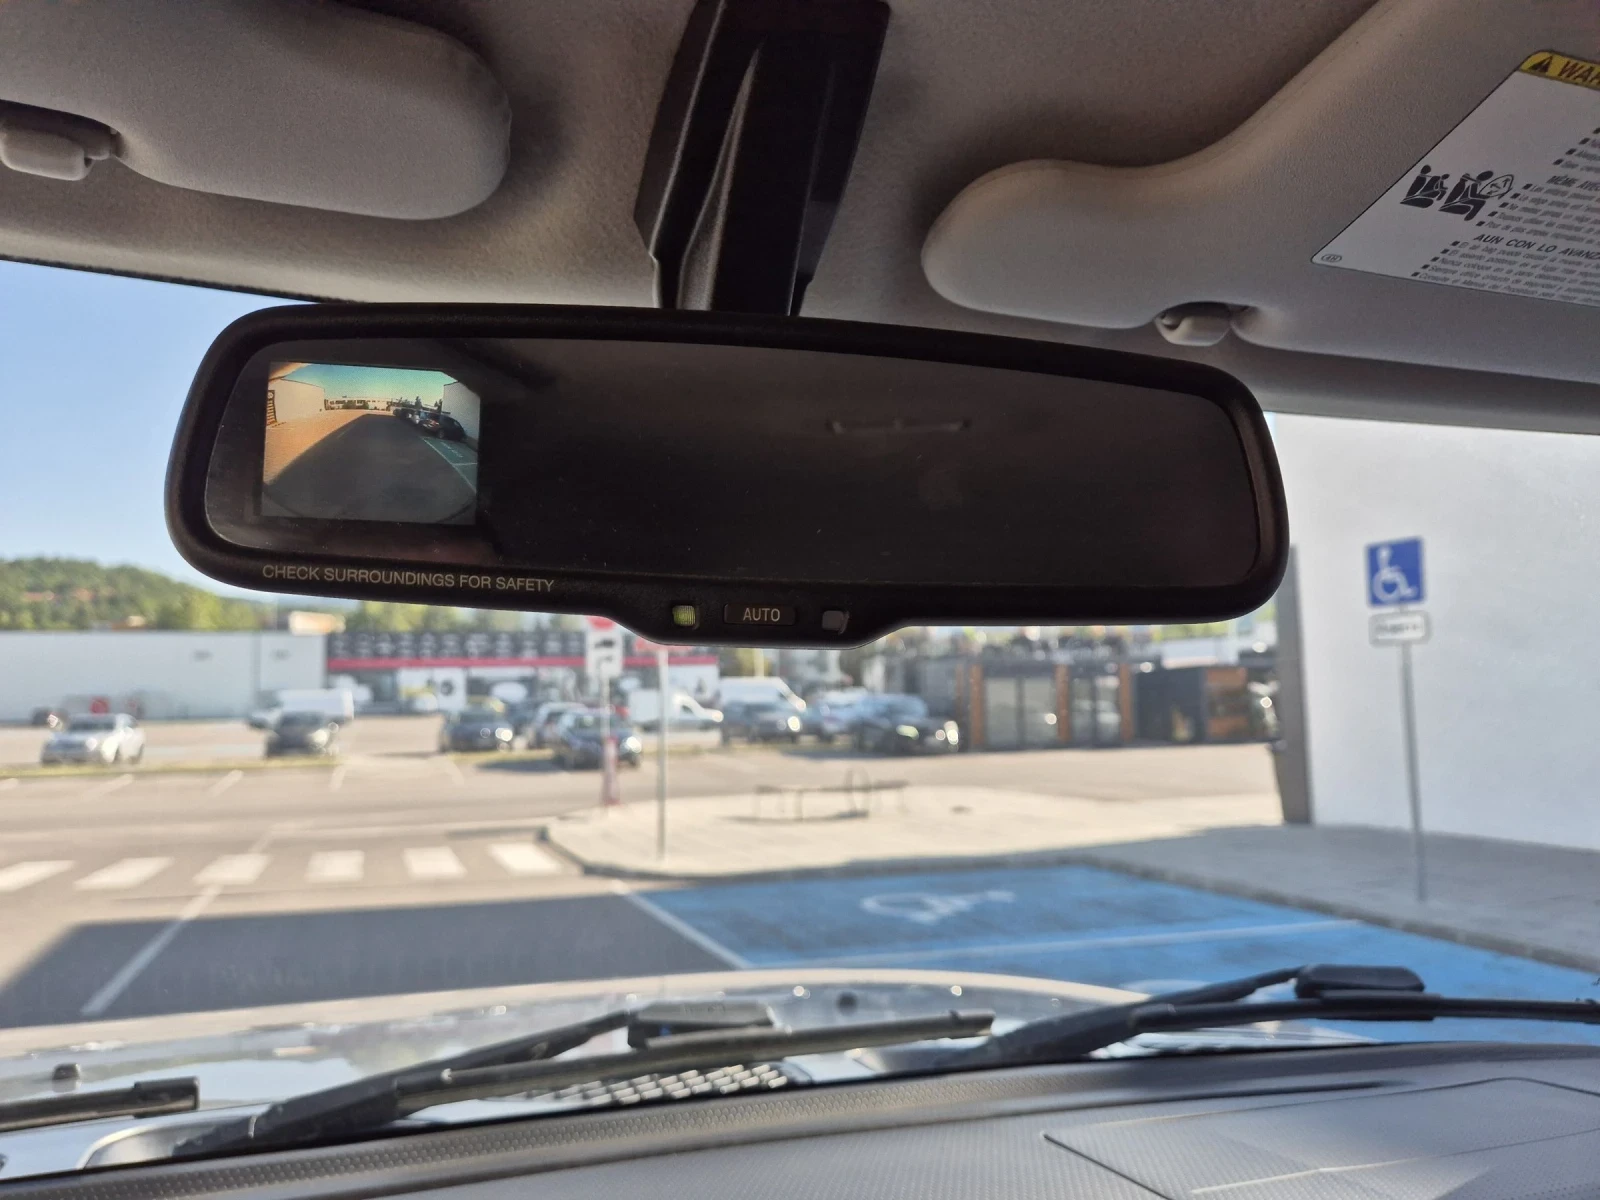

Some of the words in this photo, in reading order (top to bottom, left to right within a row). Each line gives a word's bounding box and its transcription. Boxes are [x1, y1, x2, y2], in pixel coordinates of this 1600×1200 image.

[1473, 234, 1504, 244] AUN
[1506, 239, 1537, 249] CON
[1536, 244, 1558, 253] LO
[262, 564, 320, 580] CHECK
[323, 567, 455, 587] SURROUNDINGS
[459, 574, 492, 589] FOR
[495, 576, 555, 592] SAFETY
[742, 607, 781, 622] AUTO
